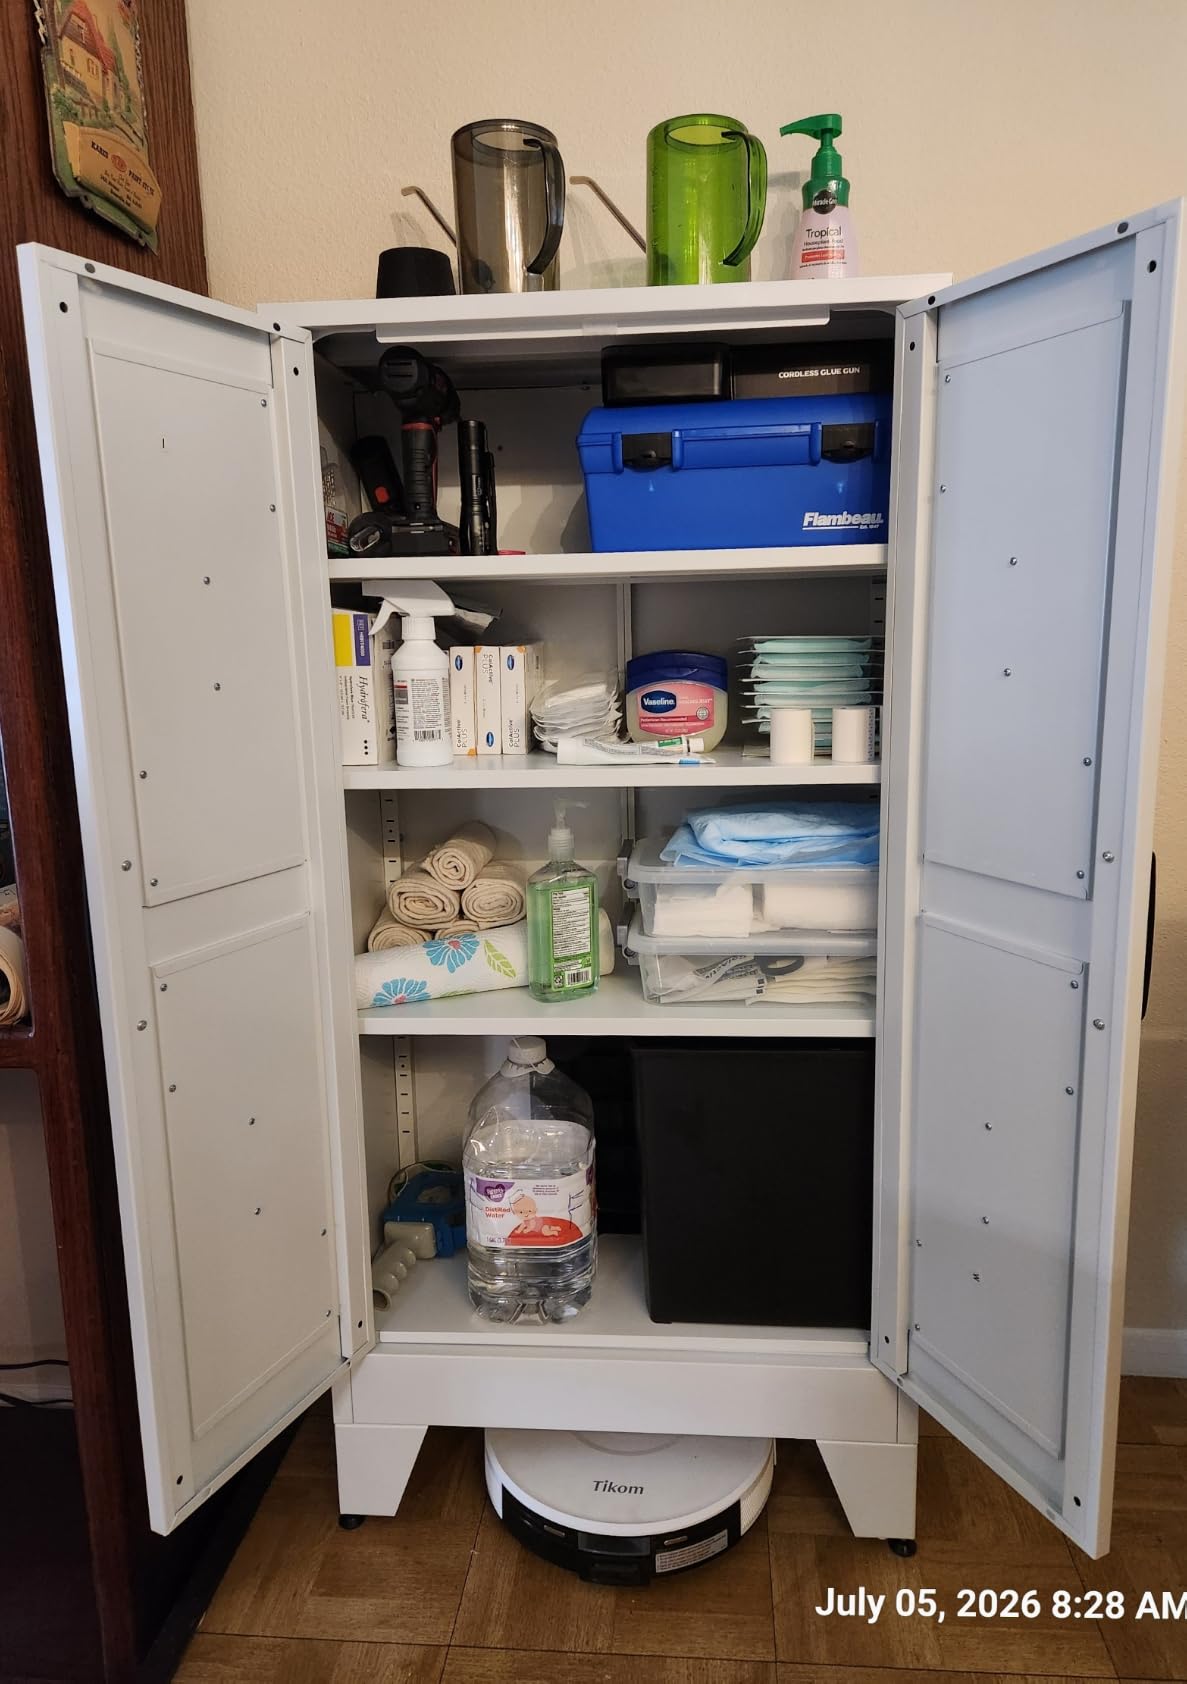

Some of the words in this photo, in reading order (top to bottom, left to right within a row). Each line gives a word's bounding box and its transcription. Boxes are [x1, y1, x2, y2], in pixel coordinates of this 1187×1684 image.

[806, 226, 842, 239] Tropical
[778, 369, 819, 379] CORDLESS
[820, 367, 842, 377] GLUE
[843, 366, 860, 375] GUN
[358, 675, 370, 720] Hydrofera
[643, 698, 675, 706] Vaseline
[592, 1479, 645, 1496] Tikom
